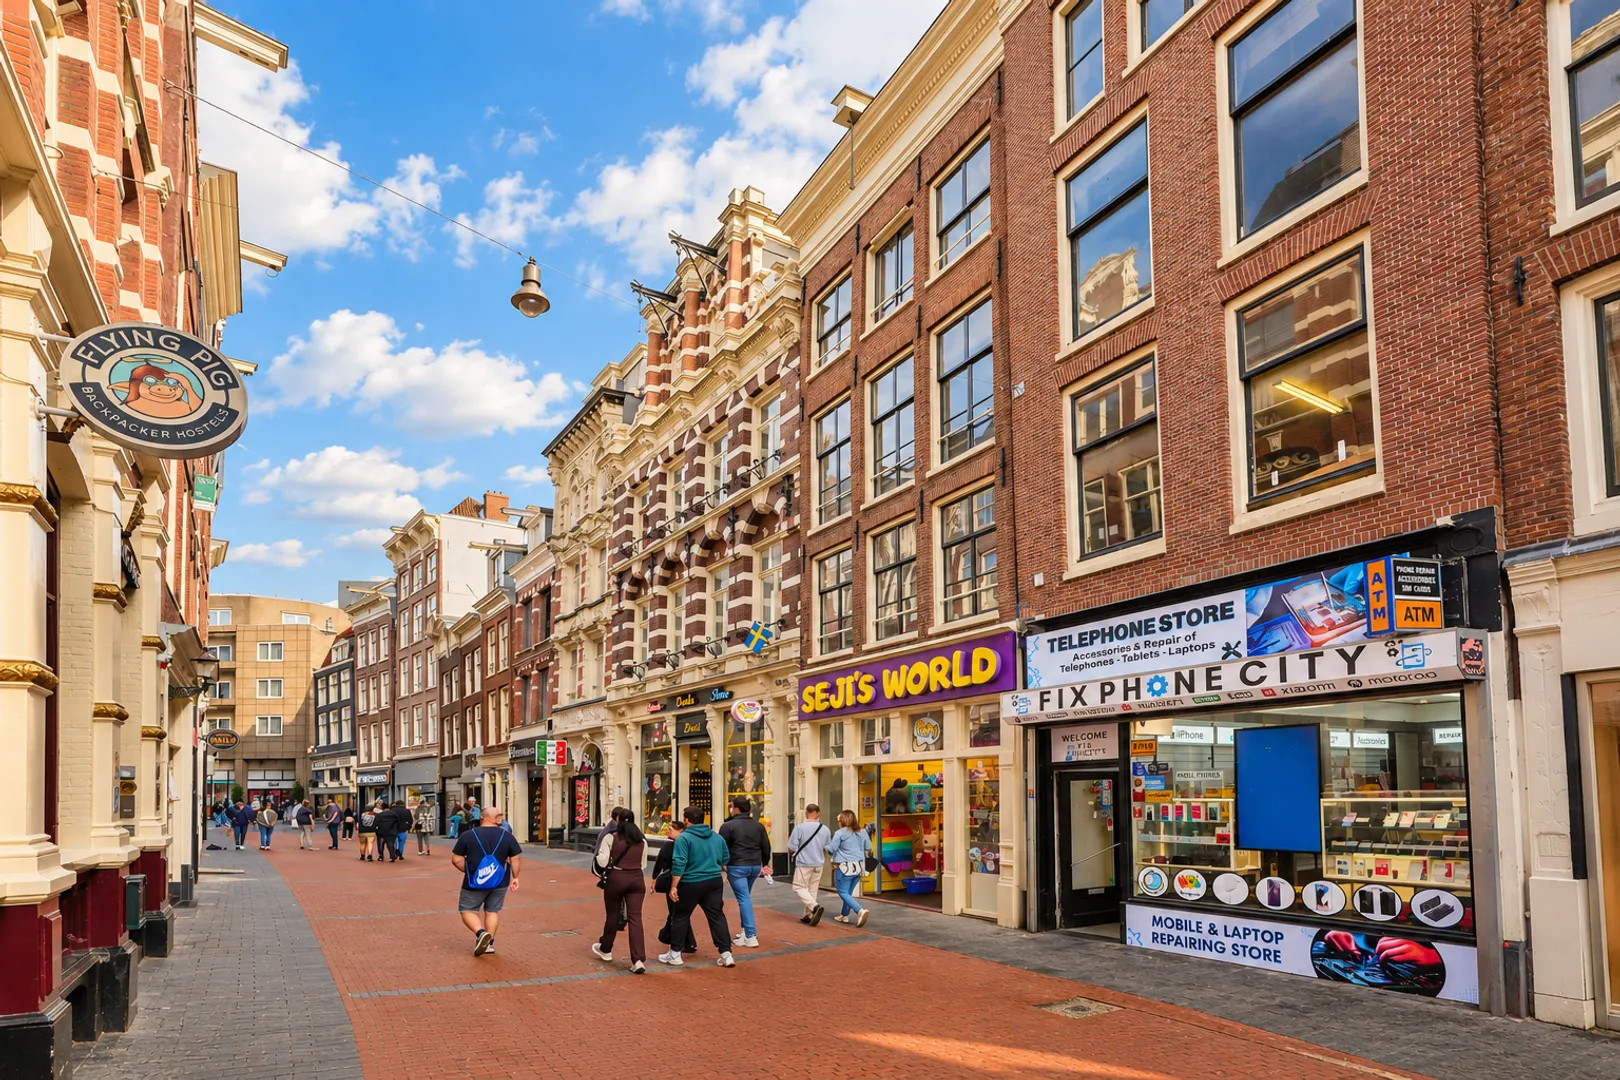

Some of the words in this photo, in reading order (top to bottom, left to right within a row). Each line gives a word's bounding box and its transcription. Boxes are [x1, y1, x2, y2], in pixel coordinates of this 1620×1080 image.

[76, 329, 181, 364] FLYING
[190, 351, 233, 388] PIG
[81, 386, 170, 439] BACKPACKER
[1371, 572, 1386, 620] ATM
[1404, 606, 1435, 622] ATM
[1047, 617, 1156, 653] TELEPHONE
[1159, 600, 1235, 632] STORE
[1073, 644, 1131, 661] Accessories
[1133, 642, 1140, 651] &
[1144, 634, 1181, 651] Repair
[1184, 631, 1196, 642] of
[1060, 656, 1114, 673] Telephones
[1122, 650, 1160, 663] Tablets
[1168, 641, 1216, 656] Laptops
[800, 670, 875, 714] SEJI'S
[882, 646, 1000, 700] WORLD
[1039, 685, 1088, 711] FIX
[1239, 645, 1367, 687] CITY
[1061, 731, 1108, 742] WELCOME
[1151, 915, 1203, 934] MOBILE
[1208, 922, 1218, 936] &
[1223, 925, 1284, 945] LAPTOP
[1151, 931, 1226, 954] REPAIRING
[1231, 943, 1282, 964] STORE
